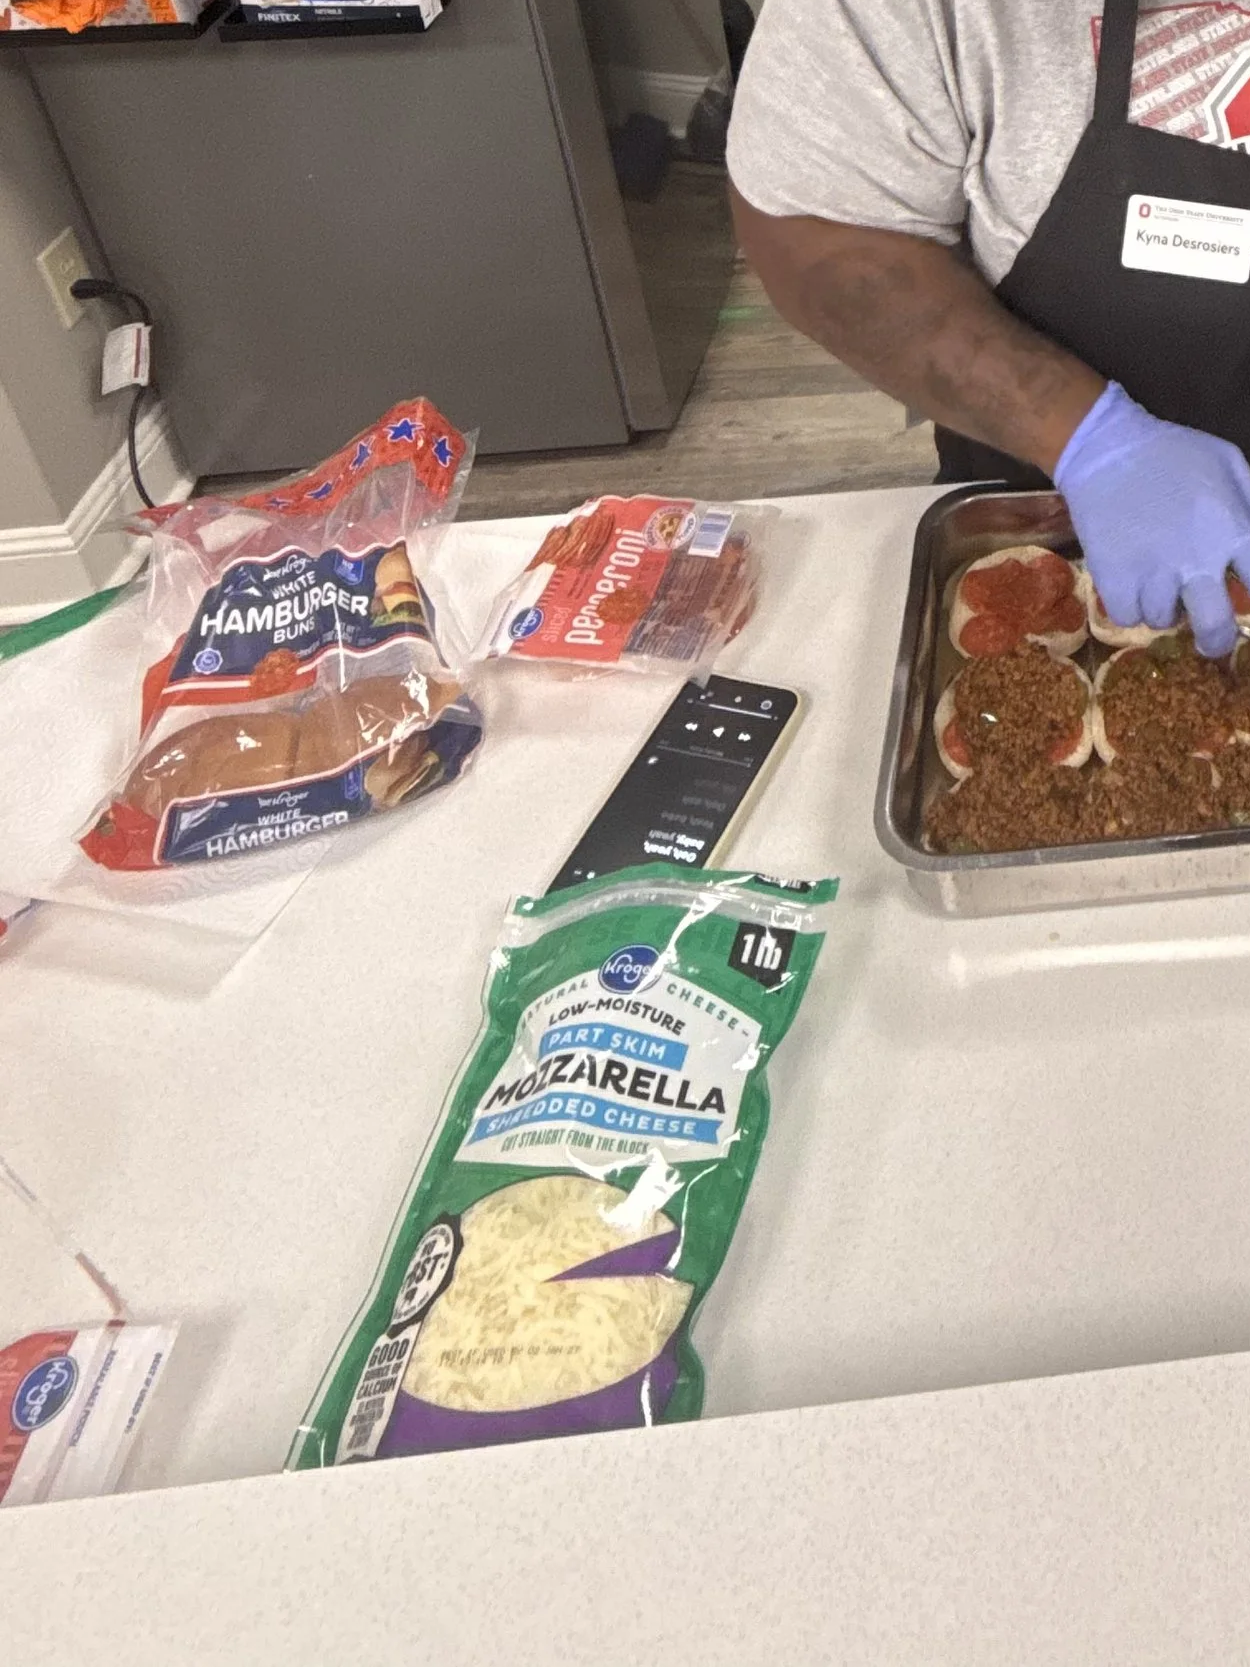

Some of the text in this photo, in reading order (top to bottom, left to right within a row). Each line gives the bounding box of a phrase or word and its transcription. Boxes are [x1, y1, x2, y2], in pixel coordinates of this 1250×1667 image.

[257, 12, 301, 23] FINITEX
[1136, 229, 1240, 256] Kyna Desrosiers
[271, 570, 317, 600] WHITE
[200, 582, 369, 636] HAMBURGER
[273, 617, 315, 644] BUNS
[258, 808, 301, 826] WHITE
[743, 933, 756, 964] 1
[604, 954, 652, 984] Kroge
[549, 997, 686, 1037] LOW-MOISTURE
[549, 1027, 667, 1061] PART SKIM
[484, 1053, 726, 1114] MOZZARELLA
[487, 1097, 697, 1135] SHREDDED CHEESE
[502, 1128, 650, 1154] CUT STRAIGHT FROM THE BLOCK
[368, 1338, 410, 1367] GOOD
[26, 1361, 68, 1424] Kroger
[356, 1377, 398, 1401] CALCIUM
